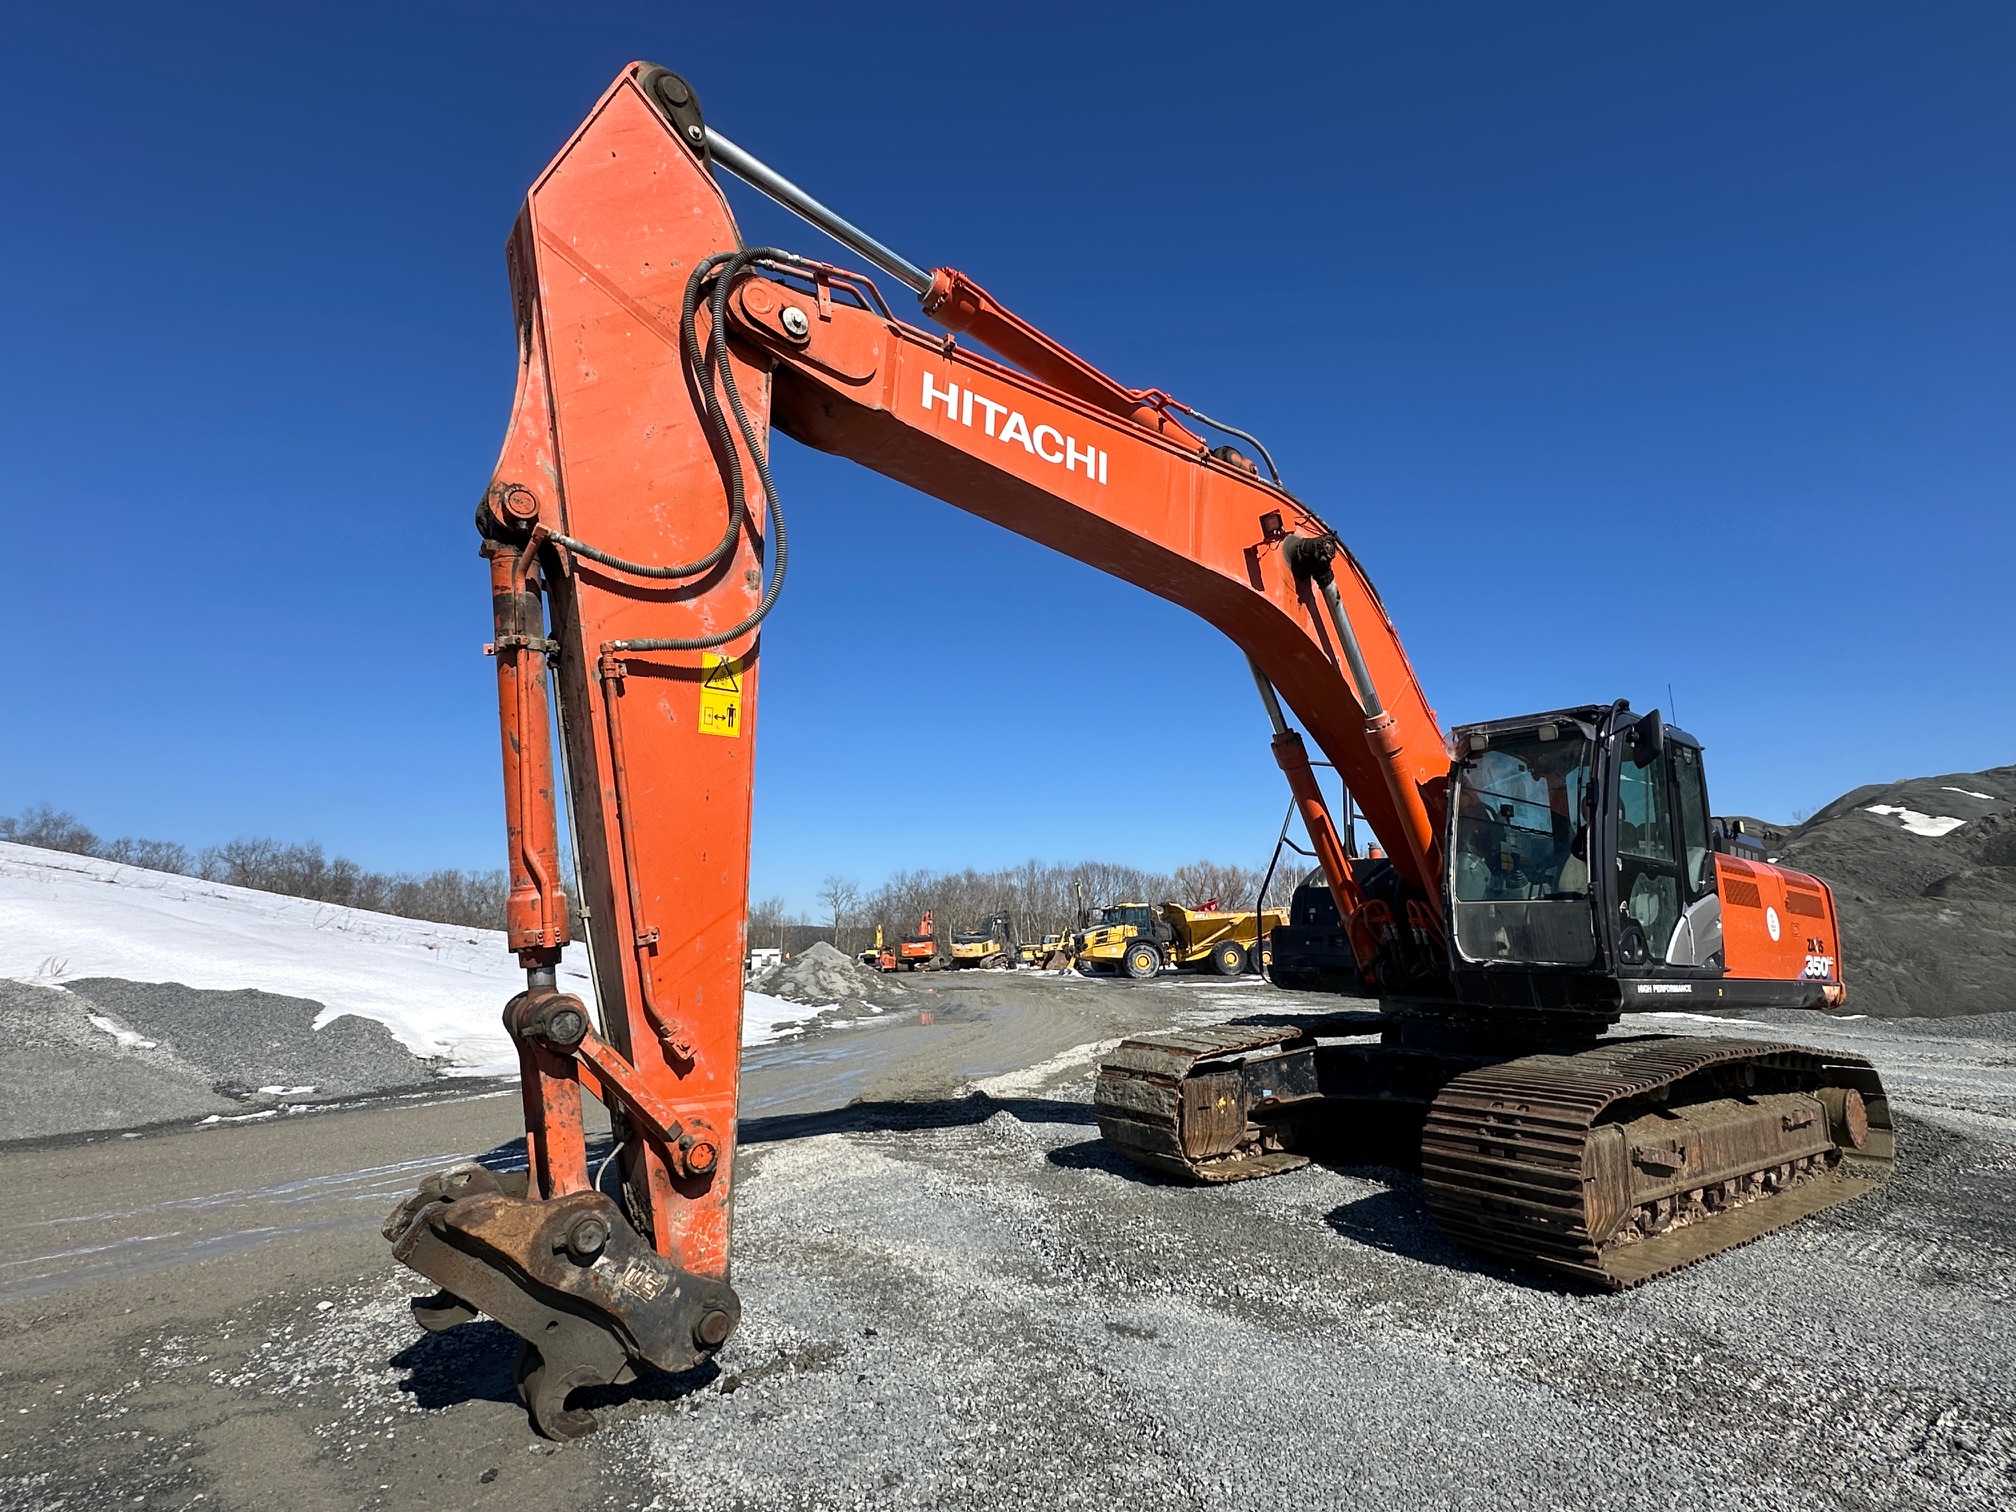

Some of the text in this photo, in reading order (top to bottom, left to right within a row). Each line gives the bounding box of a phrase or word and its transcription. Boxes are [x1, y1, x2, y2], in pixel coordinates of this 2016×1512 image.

[921, 370, 1108, 486] HITACHI
[1637, 984, 1692, 993] HIGH PERFORMANCE
